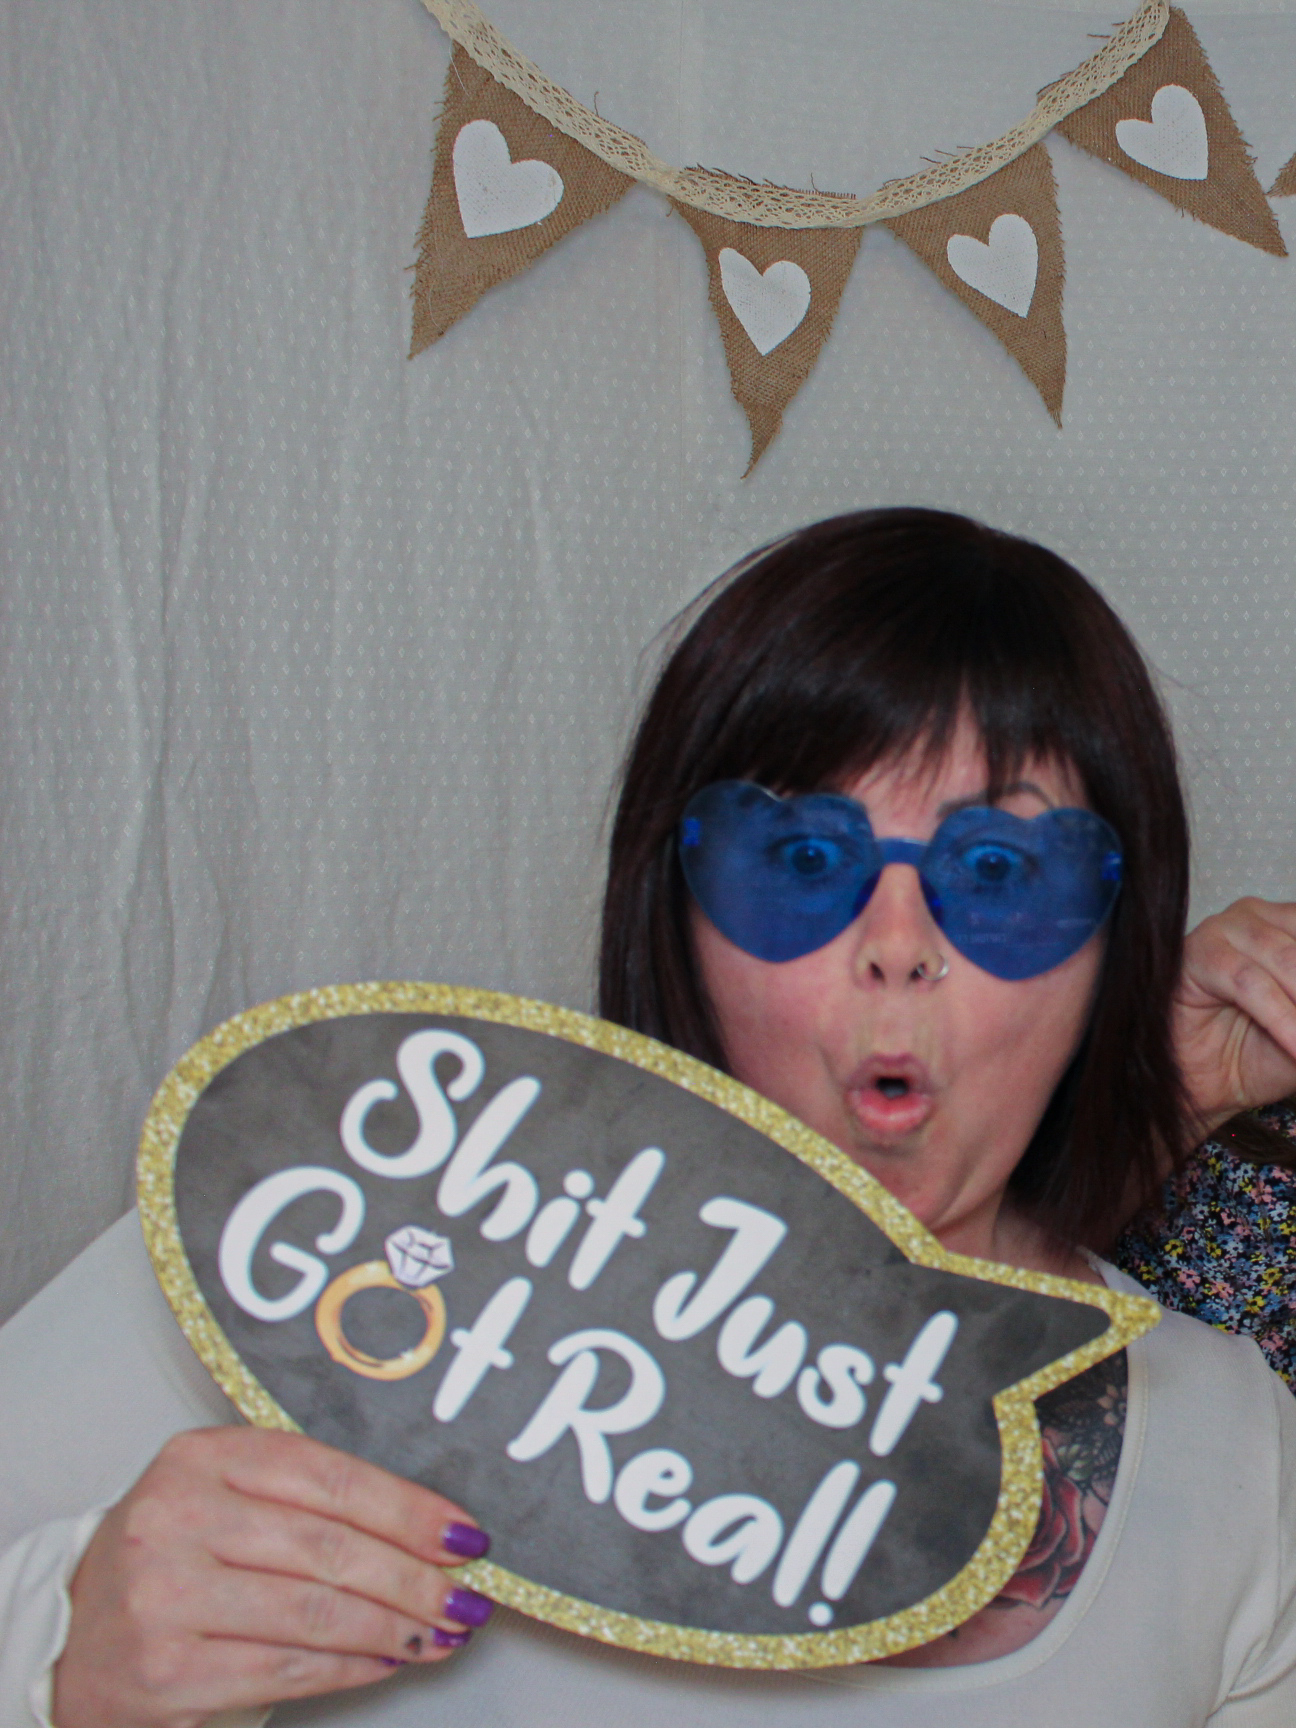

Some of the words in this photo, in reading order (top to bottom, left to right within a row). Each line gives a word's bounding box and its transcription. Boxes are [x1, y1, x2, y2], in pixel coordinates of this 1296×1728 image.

[219, 1166, 532, 1423] Got
[506, 1330, 897, 1627] Real!
[339, 1030, 663, 1291] Shit
[652, 1198, 957, 1456] Just
